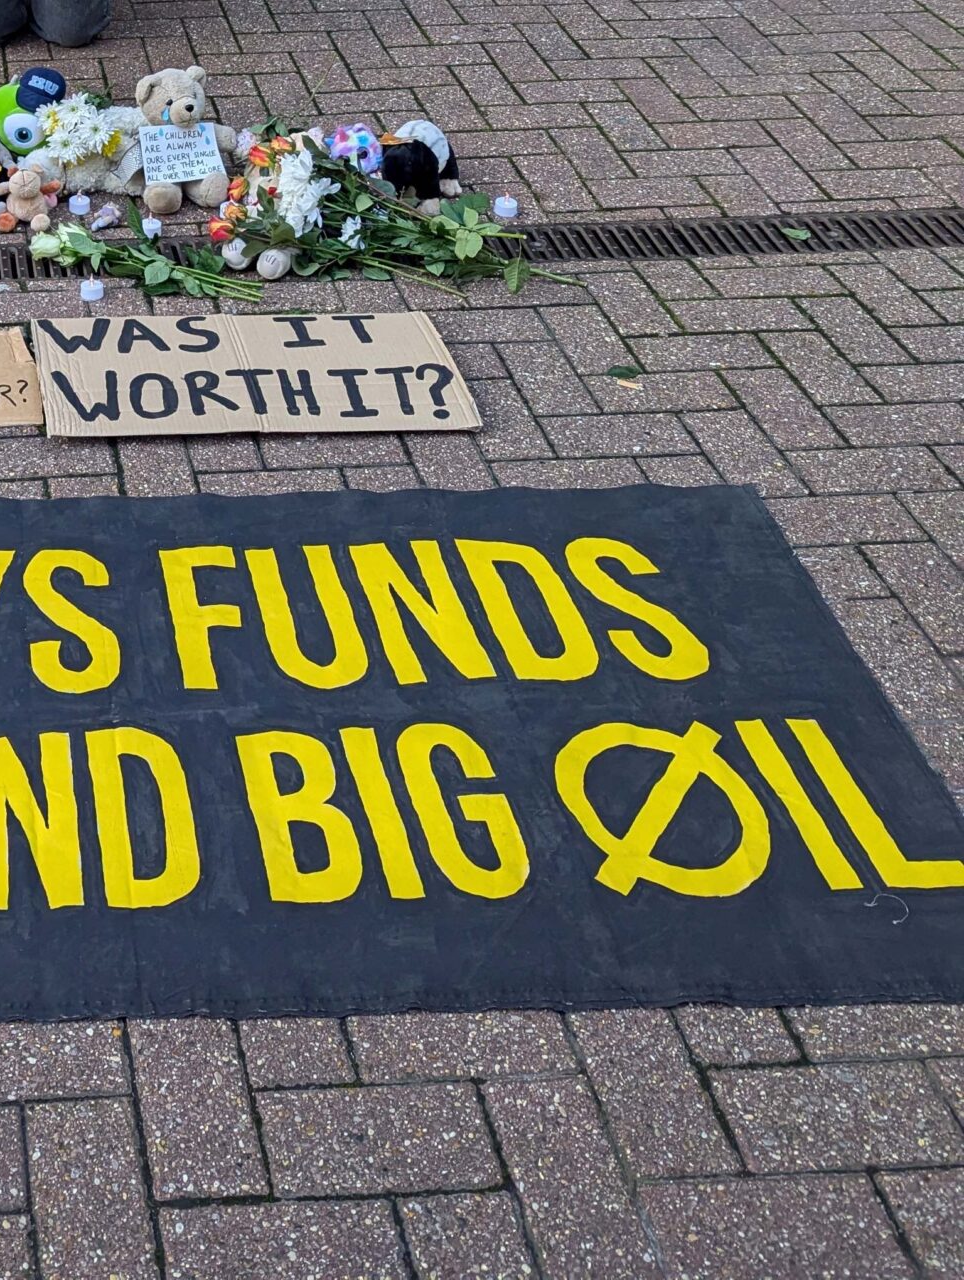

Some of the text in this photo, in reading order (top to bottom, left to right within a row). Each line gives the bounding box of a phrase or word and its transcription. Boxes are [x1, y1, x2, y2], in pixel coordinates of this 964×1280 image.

[143, 130, 203, 141] THE CHILDREN
[144, 141, 197, 154] ARE ALWAYS
[167, 152, 190, 163] EVERY
[146, 165, 163, 174] ONE
[167, 163, 177, 172] OF
[147, 174, 161, 182] ALL
[163, 171, 181, 180] OVER
[182, 170, 196, 178] THE
[37, 314, 376, 354] WAS IT
[51, 362, 455, 422] WORTH IT?
[158, 536, 710, 691] FUNDS
[236, 722, 530, 905] BIG
